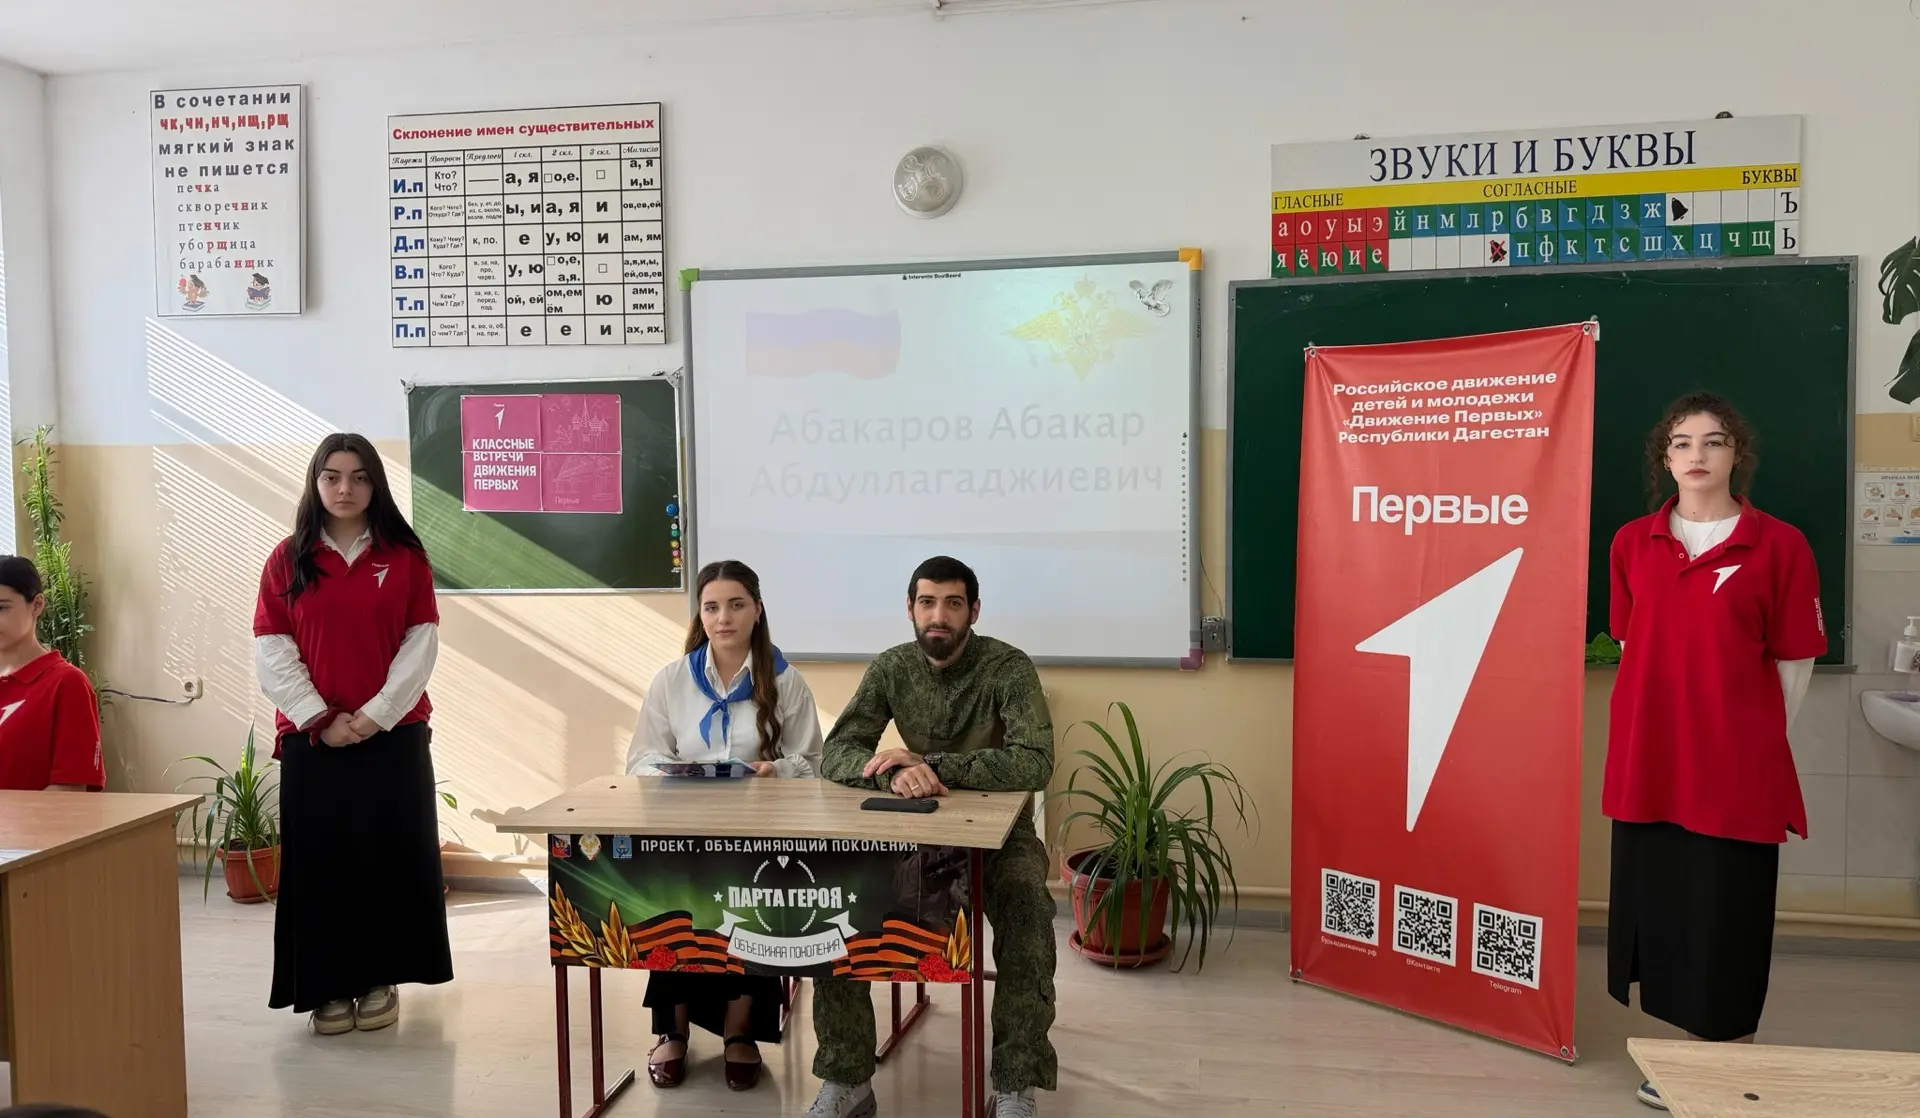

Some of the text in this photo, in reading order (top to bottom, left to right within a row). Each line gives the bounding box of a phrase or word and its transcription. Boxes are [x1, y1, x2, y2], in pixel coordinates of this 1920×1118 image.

[155, 92, 291, 109] В сочетании
[393, 119, 654, 140] Склонение имен существительных
[159, 139, 294, 155] мягкий знак
[392, 157, 422, 165] Падежи
[1369, 130, 1697, 182] ЗВУКИ И БУКВЫ
[165, 162, 289, 177] не пишется
[435, 171, 456, 179] Кто?
[1742, 168, 1797, 185] БУКВЫ
[394, 179, 423, 193] И.п
[505, 172, 538, 186] а, я
[177, 184, 219, 193] печка
[435, 183, 457, 191] Что?
[1483, 180, 1577, 198] СОГЛАСНЫЕ
[178, 202, 268, 215] скворечник
[597, 201, 608, 211] и
[1274, 193, 1344, 210] ГЛАСНЫЕ
[394, 206, 422, 220] Р.п
[506, 203, 540, 216] ы, и
[546, 202, 579, 216] а, я
[1278, 222, 1289, 237] а
[1301, 220, 1311, 236] о
[1326, 219, 1337, 240] у
[1348, 218, 1362, 233] ы
[1372, 216, 1383, 232] э
[1394, 210, 1406, 231] й
[1418, 214, 1428, 230] н
[1440, 214, 1455, 229] м
[1467, 213, 1479, 228] л
[1492, 210, 1503, 232] р
[1516, 205, 1528, 228] б
[1541, 209, 1551, 224] в
[1567, 207, 1578, 222] г
[1592, 205, 1604, 224] д
[1780, 192, 1798, 213] Ъ
[179, 222, 239, 231] птенчик
[394, 236, 424, 253] Д.п
[519, 233, 530, 245] е
[546, 231, 581, 245] у, ю
[598, 232, 608, 243] и
[624, 233, 643, 242] ам,
[179, 240, 256, 253] уборщица
[1276, 253, 1287, 267] я
[1299, 249, 1309, 268] ё
[1321, 251, 1338, 267] ю
[1349, 250, 1360, 265] и
[1372, 248, 1382, 264] е
[1516, 242, 1529, 258] п
[1540, 235, 1554, 262] ф
[1567, 239, 1578, 254] к
[1595, 238, 1605, 253] т
[1728, 232, 1741, 248] ч
[1782, 228, 1796, 249] Ь
[180, 257, 274, 272] барабанщик
[508, 262, 543, 277] у, ю
[395, 265, 424, 279] В.п
[632, 287, 658, 295] ами,
[396, 297, 424, 310] Т.п
[507, 294, 544, 305] ой, ей
[596, 294, 612, 305] ю
[547, 303, 563, 312] ём
[396, 324, 425, 338] П.п
[521, 325, 532, 336] е
[561, 324, 572, 335] е
[601, 324, 611, 335] и
[627, 325, 643, 334] ах,
[1333, 372, 1557, 396] Российское движение
[1352, 391, 1534, 412] детей и молодежи
[1343, 409, 1542, 429] «Движение Первых»
[768, 402, 1147, 452] Абакаров Абакар
[1338, 426, 1549, 445] Республики Дагестан
[473, 439, 534, 449] КЛАССНЫЕ
[474, 451, 523, 461] ВСТРЕЧИ
[474, 465, 536, 477] ДВИЖЕНИЯ
[474, 479, 518, 490] ПЕРВЫХ
[748, 461, 1163, 505] Абдуллагаджиевич
[1352, 486, 1528, 535] Первые
[641, 838, 918, 853] ПРОЕКТ, ОБЪЕДИНЯЮЩИЙ ПОКОЛЕНИЯ
[728, 886, 842, 908] ПАРТА ГЕРОЯ
[790, 938, 840, 958] ПОКОЛЕНИЯ
[1406, 958, 1440, 973] ВКонтакте
[1489, 980, 1522, 994] Telegram
